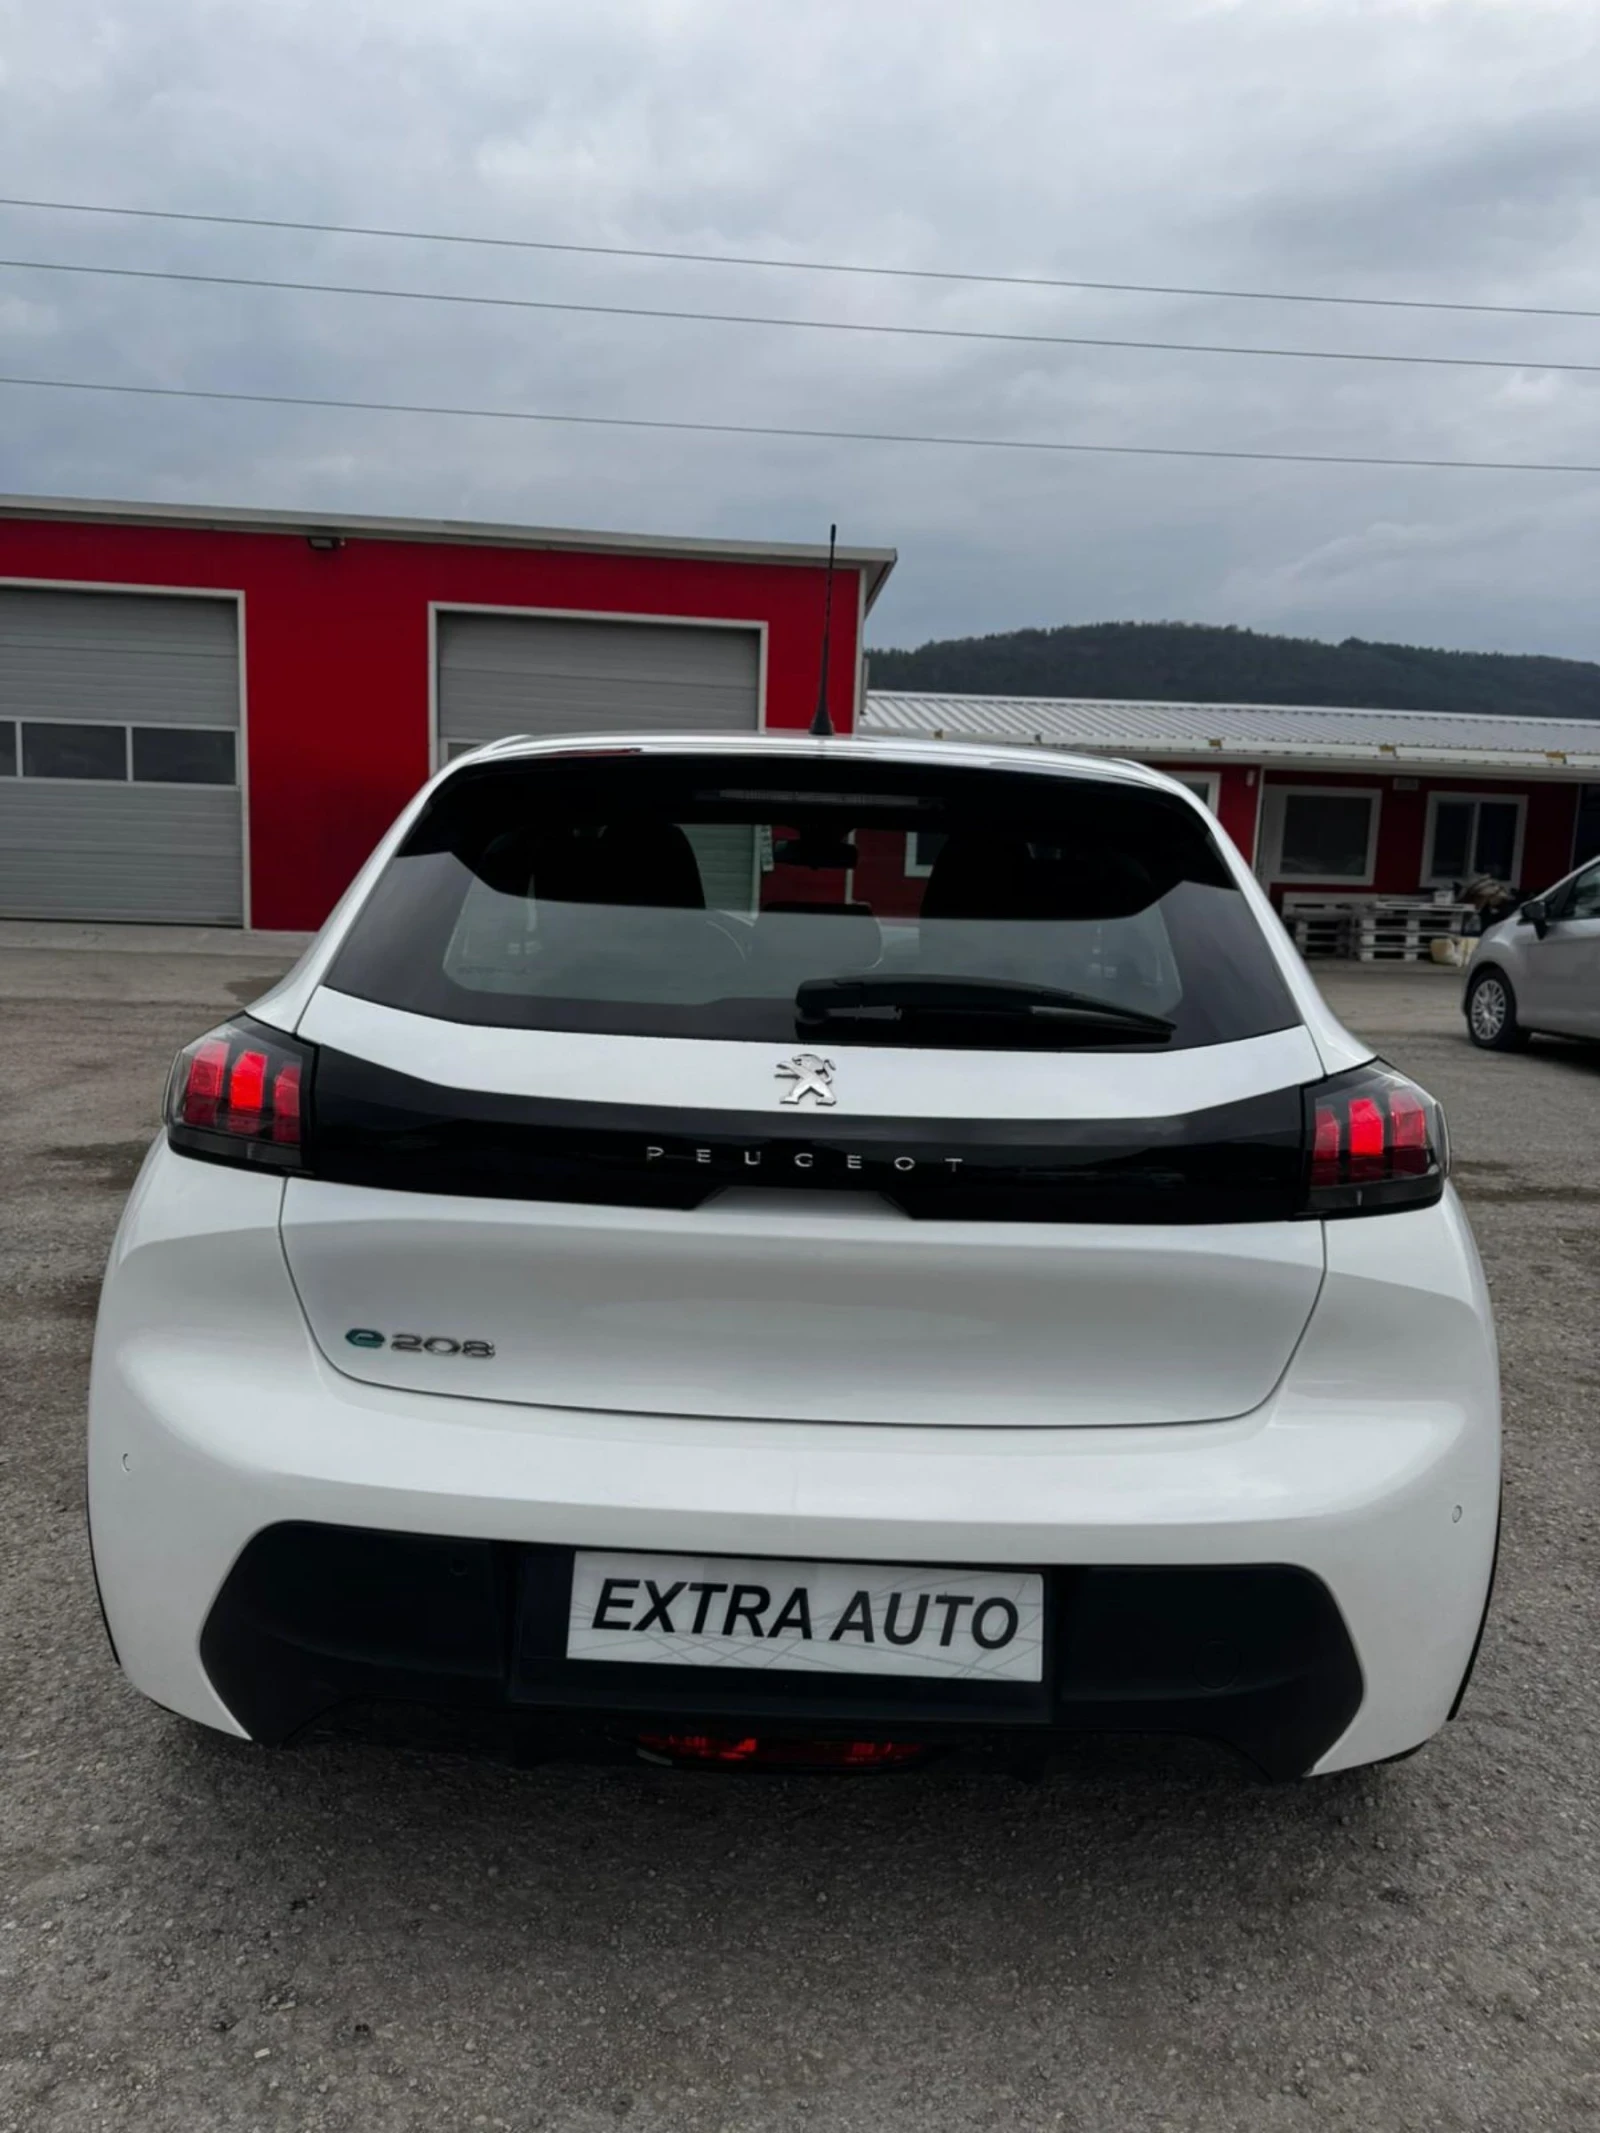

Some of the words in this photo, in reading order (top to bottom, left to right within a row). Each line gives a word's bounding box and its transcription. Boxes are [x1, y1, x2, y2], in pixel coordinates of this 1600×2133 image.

[646, 1146, 963, 1172] PEUGEOT
[592, 1578, 812, 1640] EXTRA
[829, 1590, 1019, 1650] AUTO
